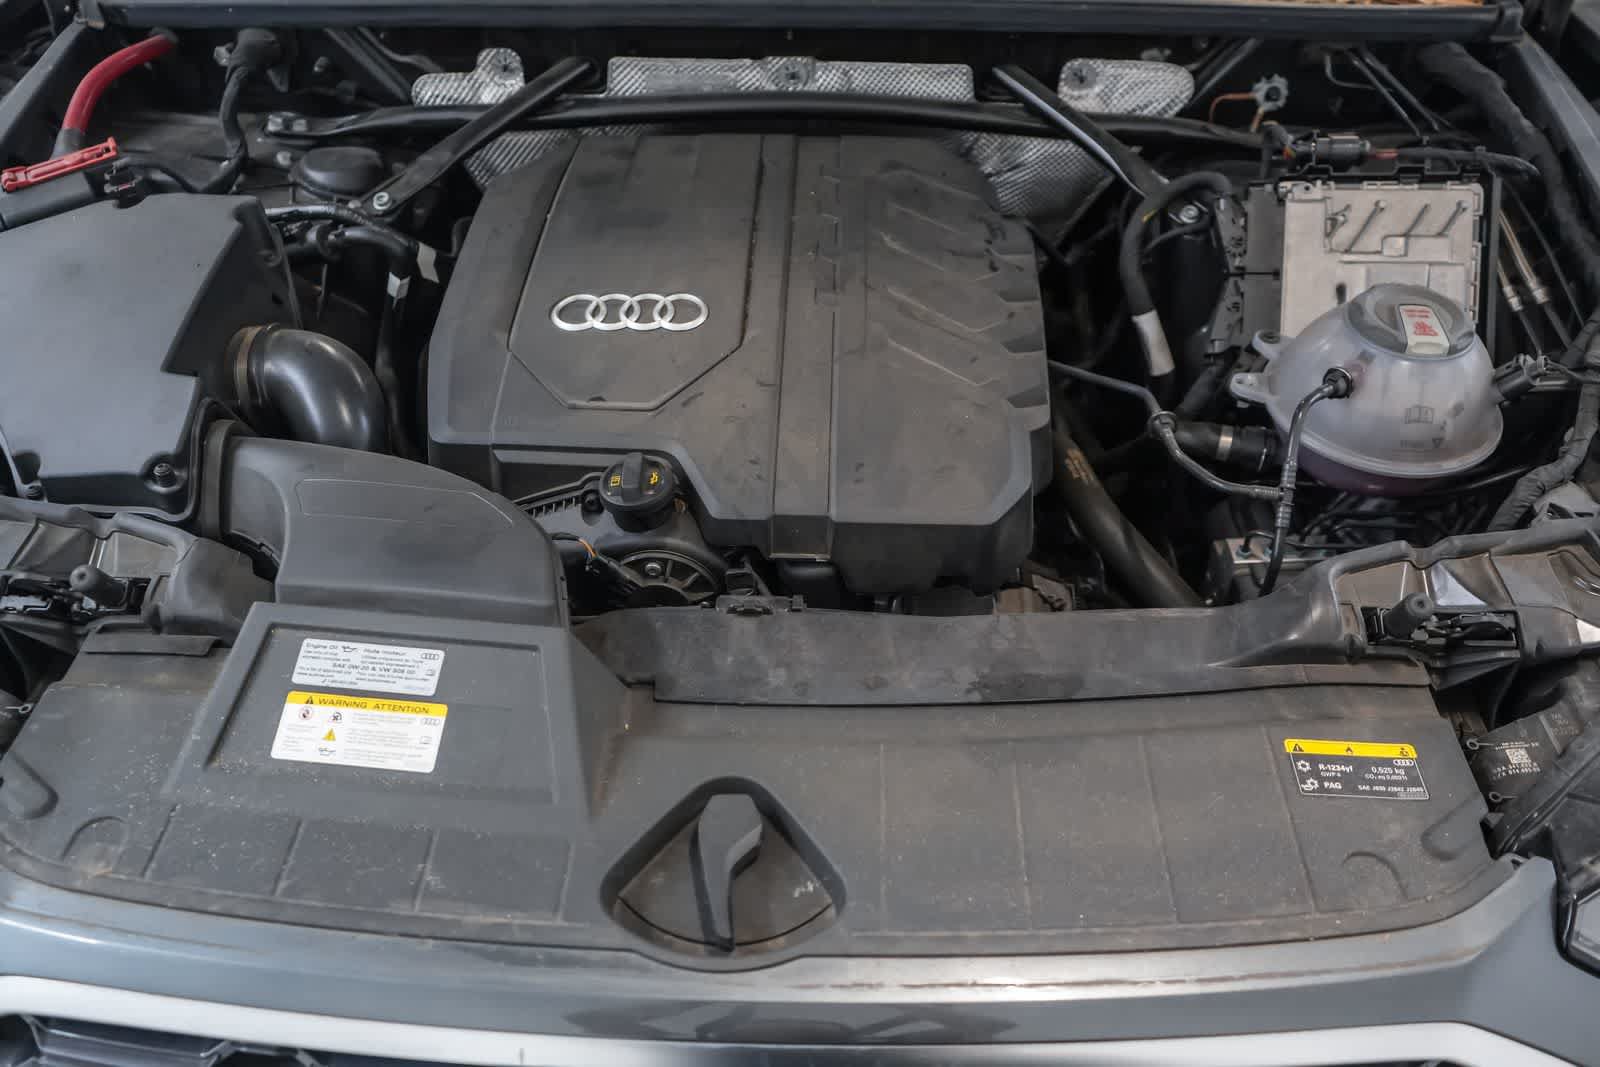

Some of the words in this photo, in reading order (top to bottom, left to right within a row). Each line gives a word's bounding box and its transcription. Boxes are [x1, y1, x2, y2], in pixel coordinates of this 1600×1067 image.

[306, 642, 327, 650] Engine
[318, 697, 368, 709] WARNING
[373, 702, 431, 715] ATTENTION
[1318, 763, 1353, 773] R-1234yf
[1394, 767, 1406, 776] kg
[1323, 781, 1342, 790] PAG
